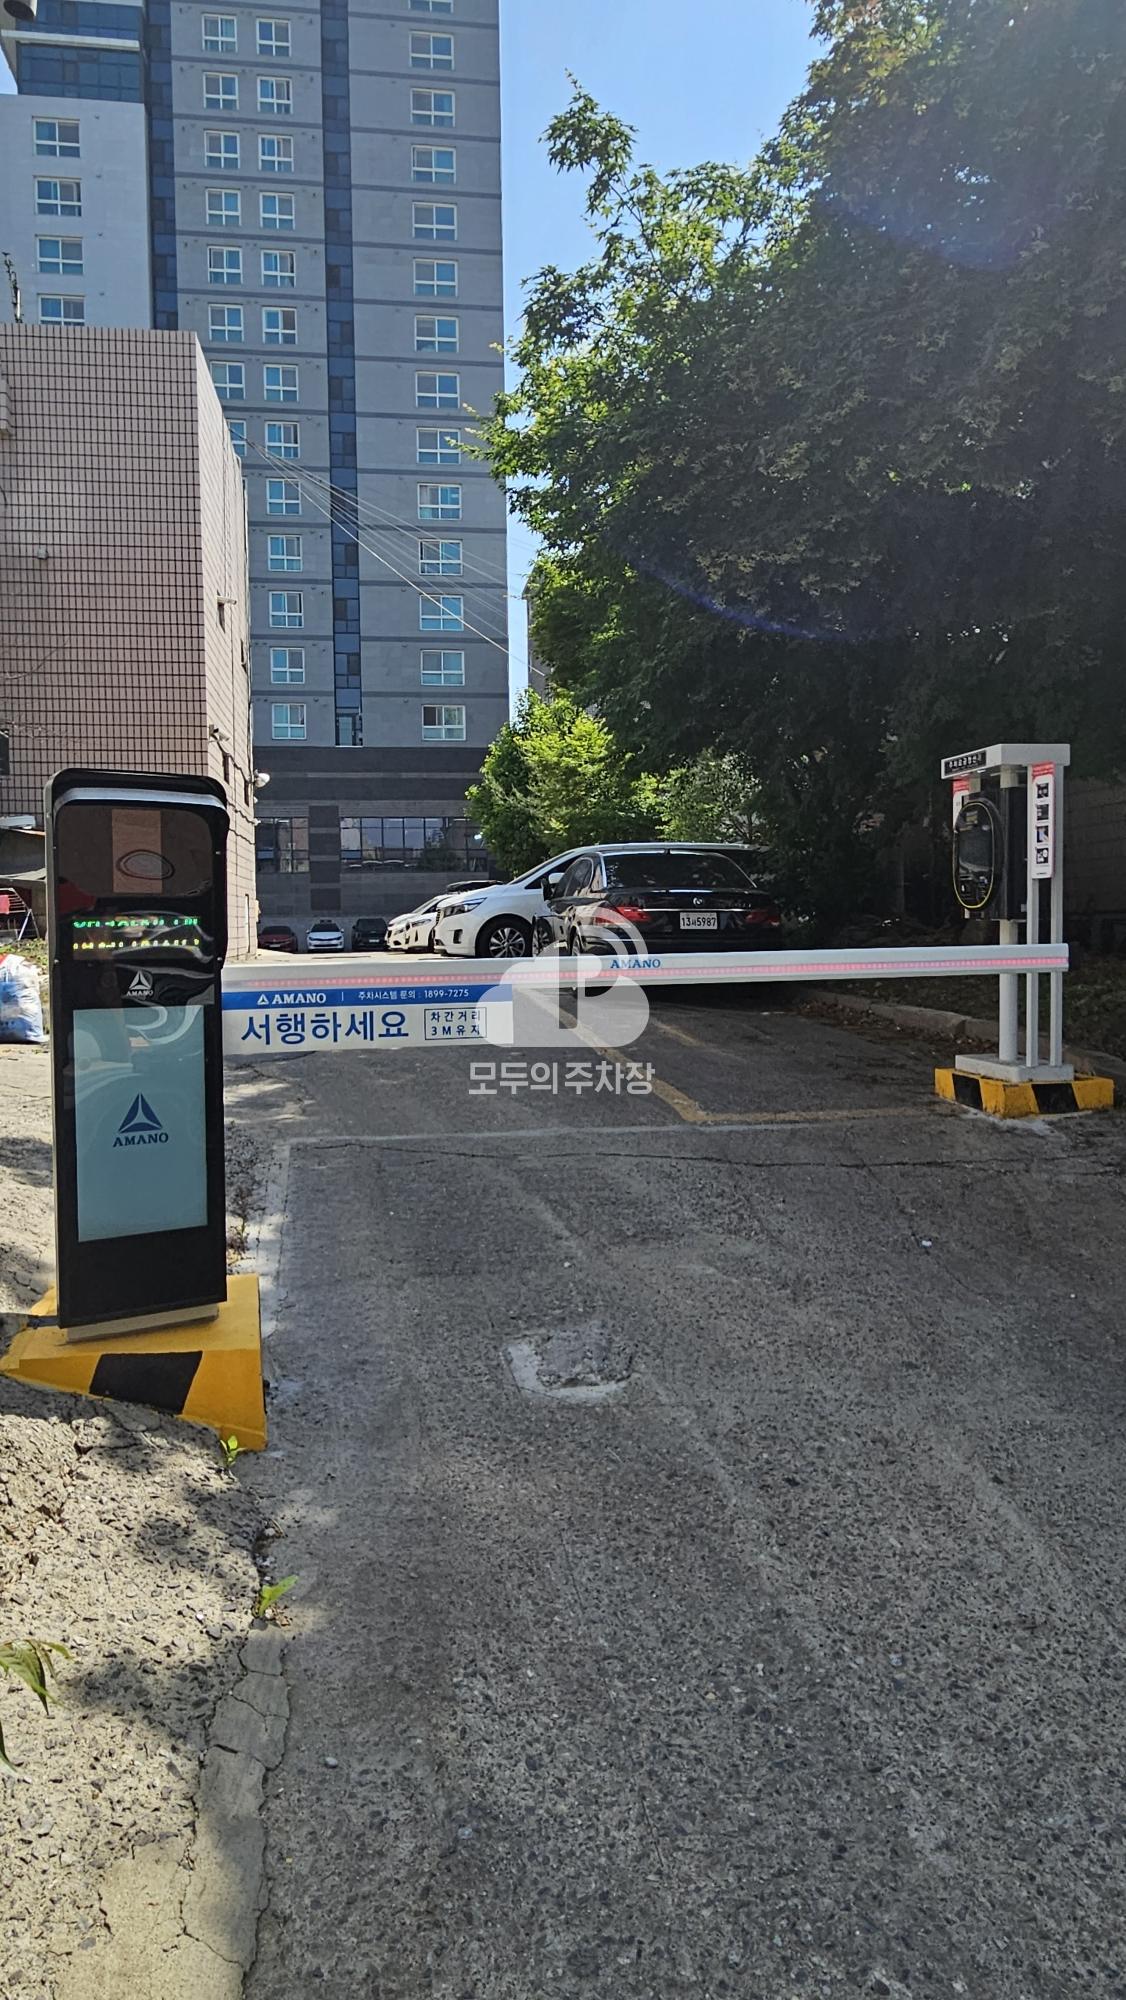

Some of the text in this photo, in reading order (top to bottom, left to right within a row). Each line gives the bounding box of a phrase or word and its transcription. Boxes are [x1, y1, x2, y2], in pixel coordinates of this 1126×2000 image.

[610, 959, 661, 969] AMANO
[271, 989, 469, 1005] AMANO 주차시스템 문의 1899-7275
[241, 1011, 409, 1045] 서행하세요
[113, 1132, 169, 1148] AMANO
